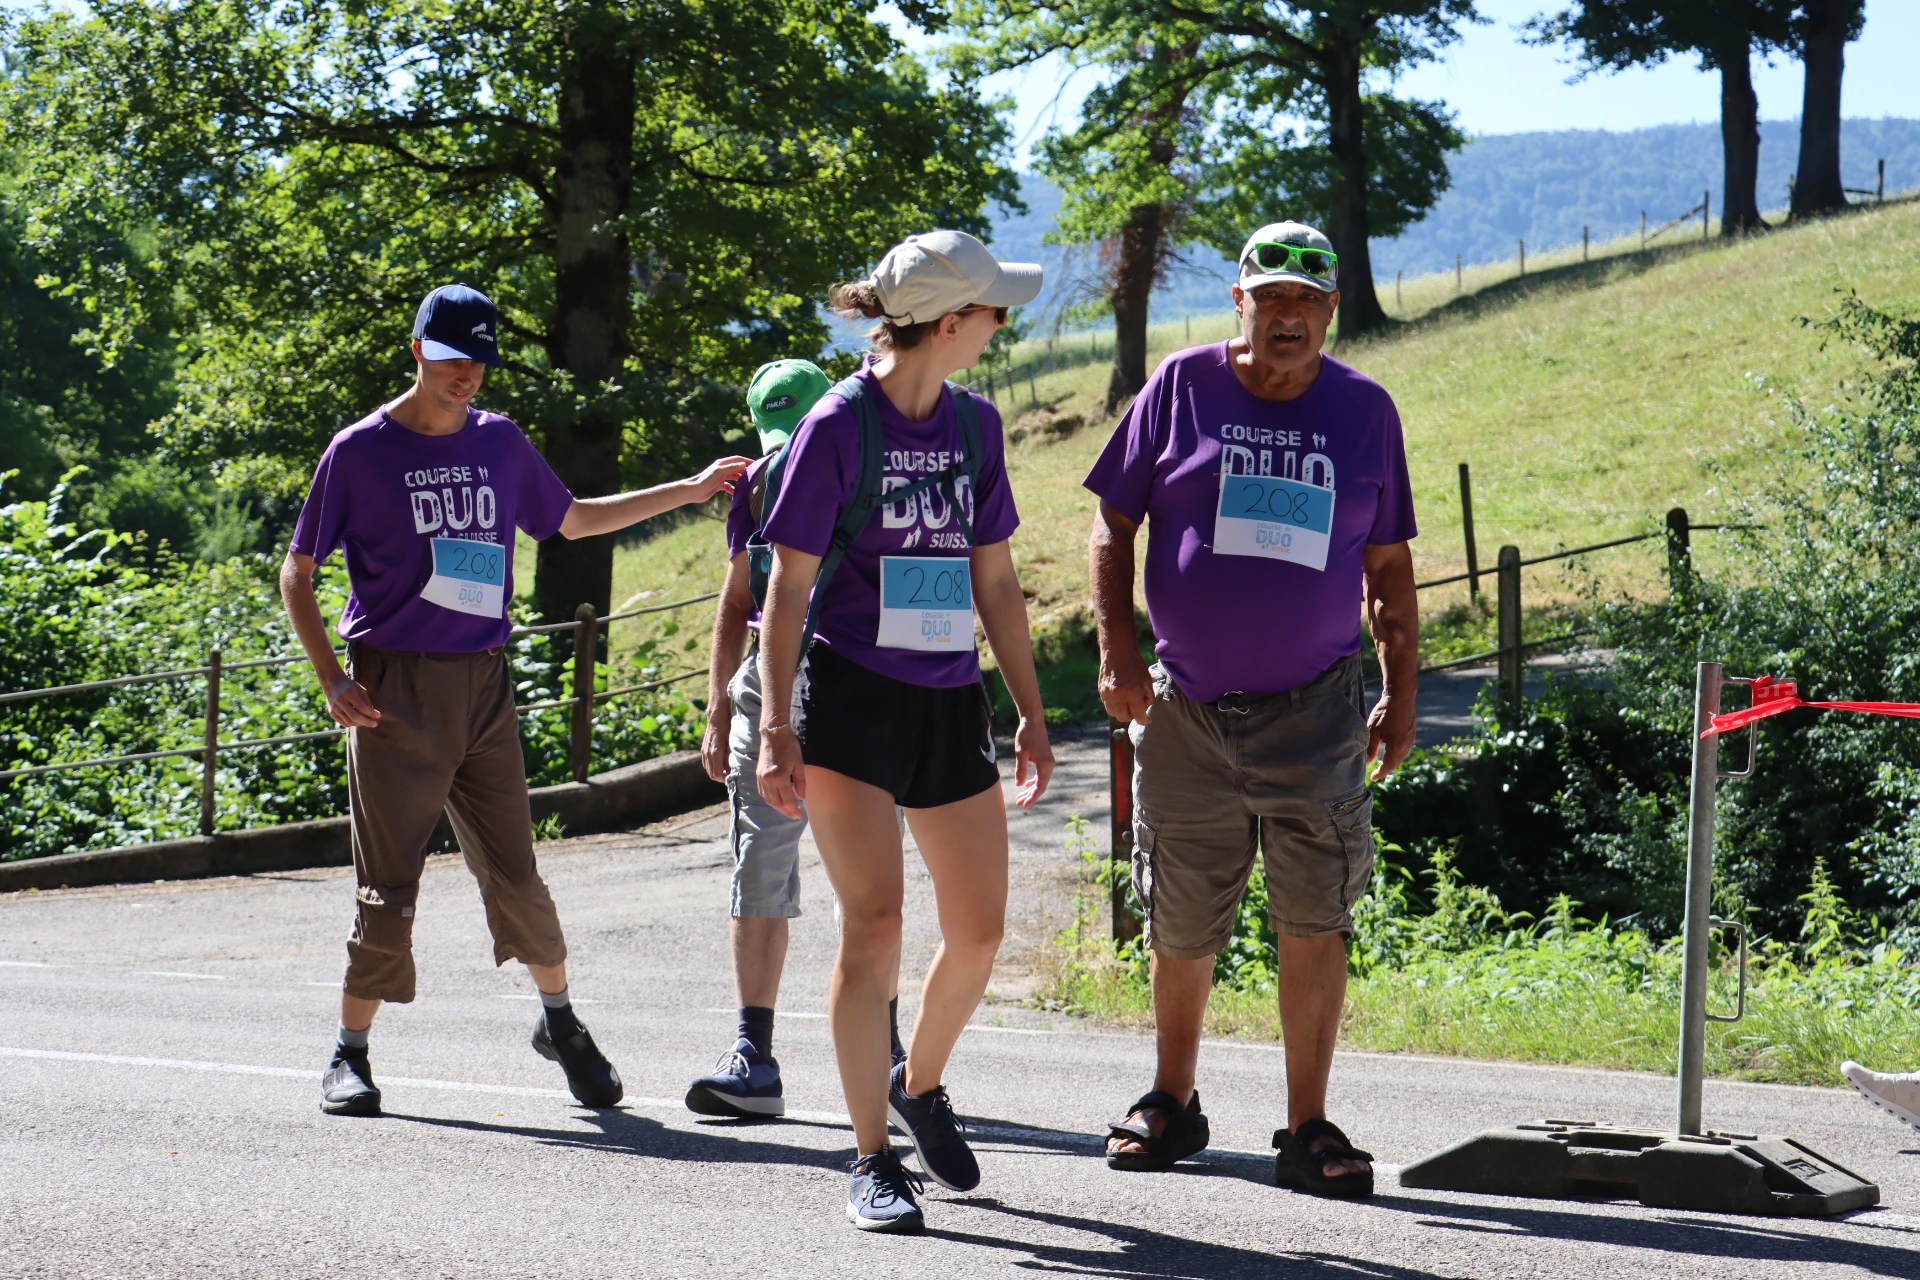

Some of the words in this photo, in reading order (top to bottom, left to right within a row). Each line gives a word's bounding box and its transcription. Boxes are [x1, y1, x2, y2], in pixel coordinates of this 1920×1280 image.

[1221, 424, 1302, 446] COURSE
[883, 450, 950, 472] COURSE
[404, 466, 472, 487] COURSE
[410, 485, 496, 534] DUO
[882, 474, 974, 529] DUO
[1243, 484, 1308, 523] 208
[1256, 529, 1292, 547] DUO
[453, 547, 498, 579] 208
[458, 587, 483, 604] DUO
[904, 566, 964, 604] 208
[921, 619, 952, 636] DUO
